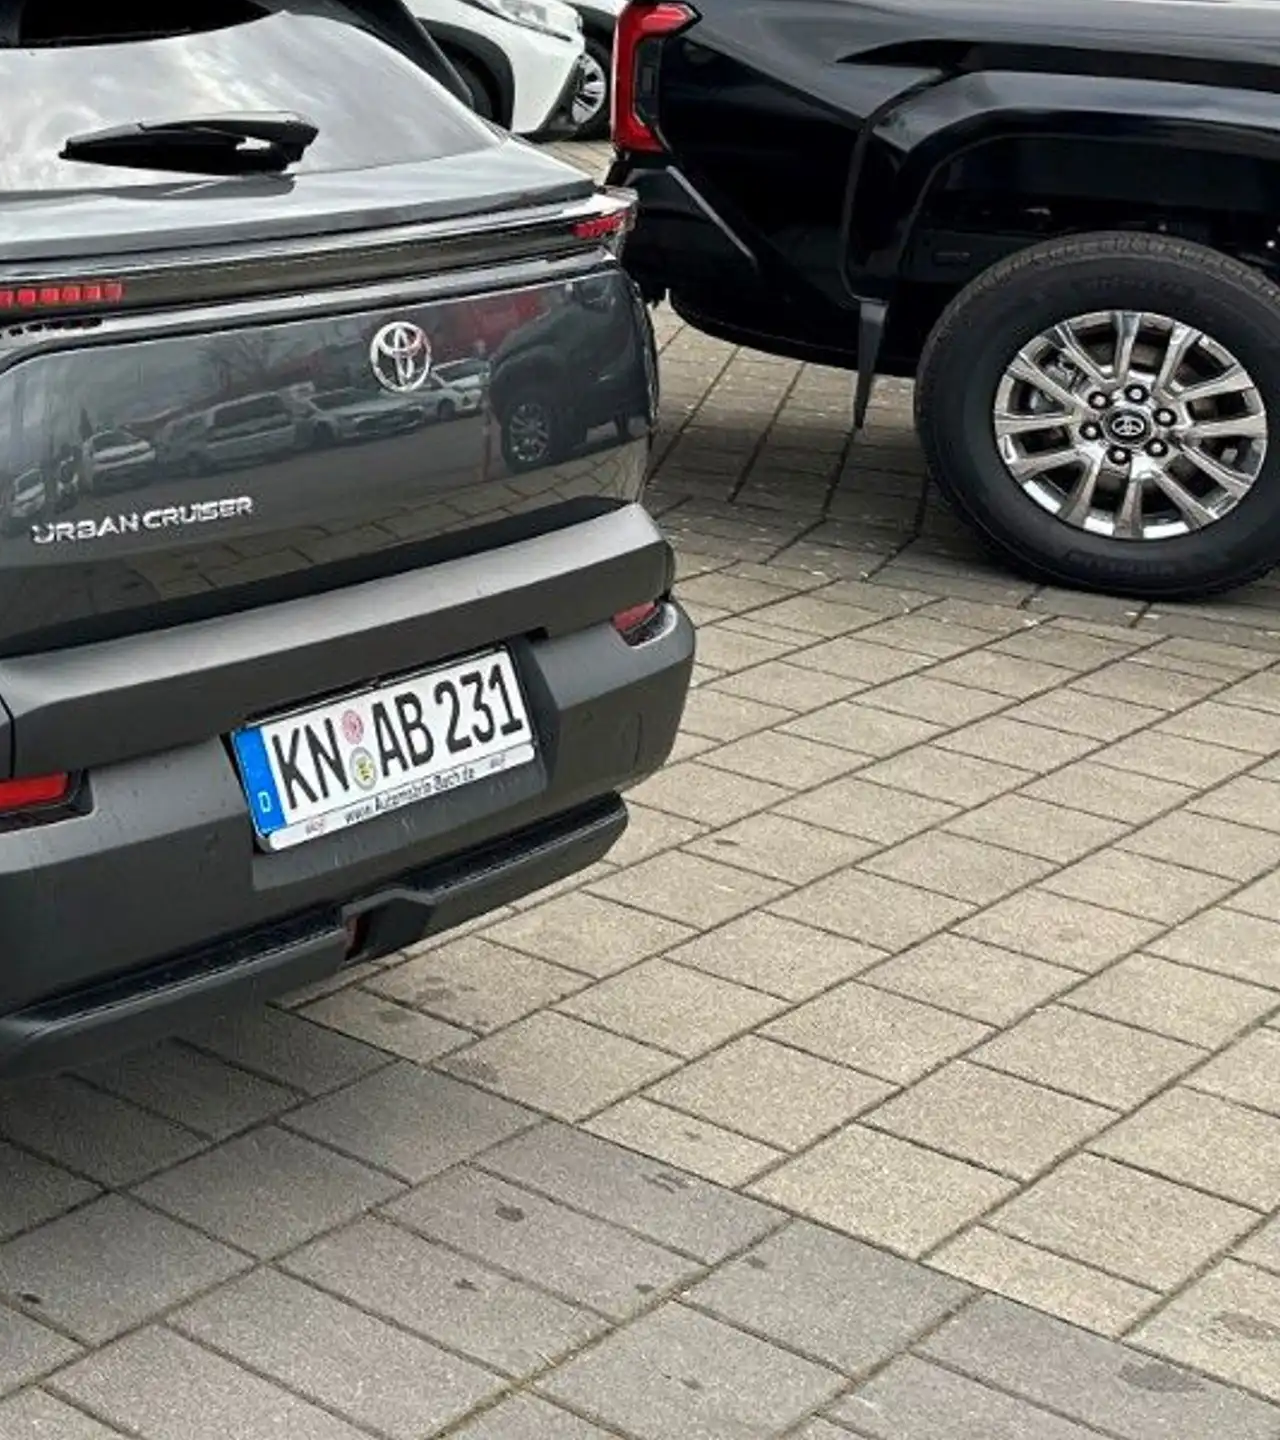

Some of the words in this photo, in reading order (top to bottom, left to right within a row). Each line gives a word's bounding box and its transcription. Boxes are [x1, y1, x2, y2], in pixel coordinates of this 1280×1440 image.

[32, 512, 139, 544] URBAN
[142, 496, 253, 530] CRUISER
[272, 717, 350, 809] KN
[371, 691, 434, 777] AB
[434, 664, 523, 754] 231
[257, 791, 272, 813] D
